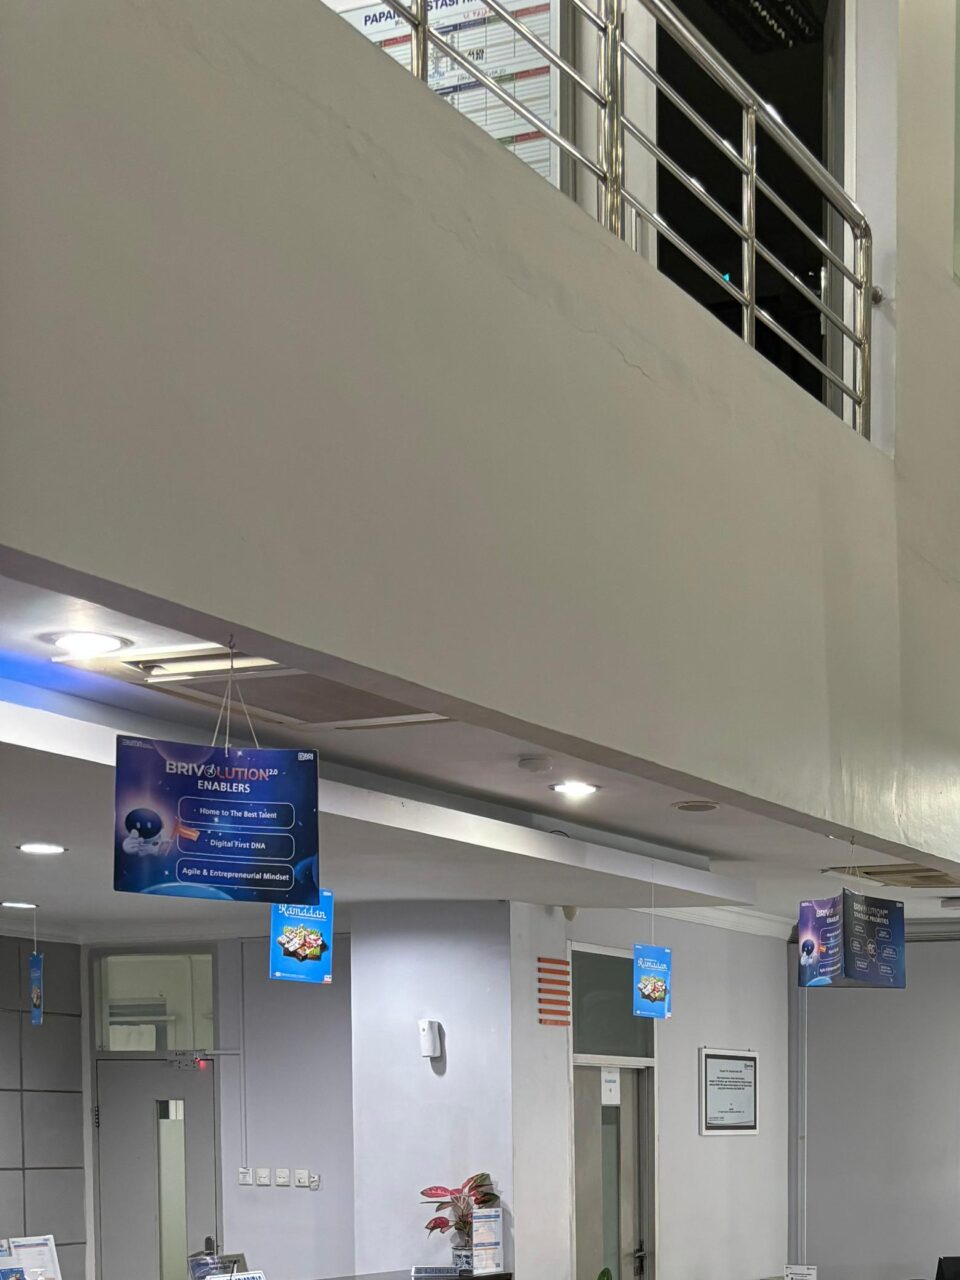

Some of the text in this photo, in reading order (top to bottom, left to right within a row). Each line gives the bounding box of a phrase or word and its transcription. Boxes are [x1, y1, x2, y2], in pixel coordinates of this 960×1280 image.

[198, 781, 251, 793] ENABLERS
[200, 808, 220, 816] Home
[243, 811, 258, 819] Best
[259, 811, 277, 819] Talent
[210, 839, 234, 850] Digital
[235, 841, 250, 849] First
[182, 867, 201, 876] Agile
[210, 869, 262, 880] Entrepreneurial
[263, 873, 289, 881] Mindset
